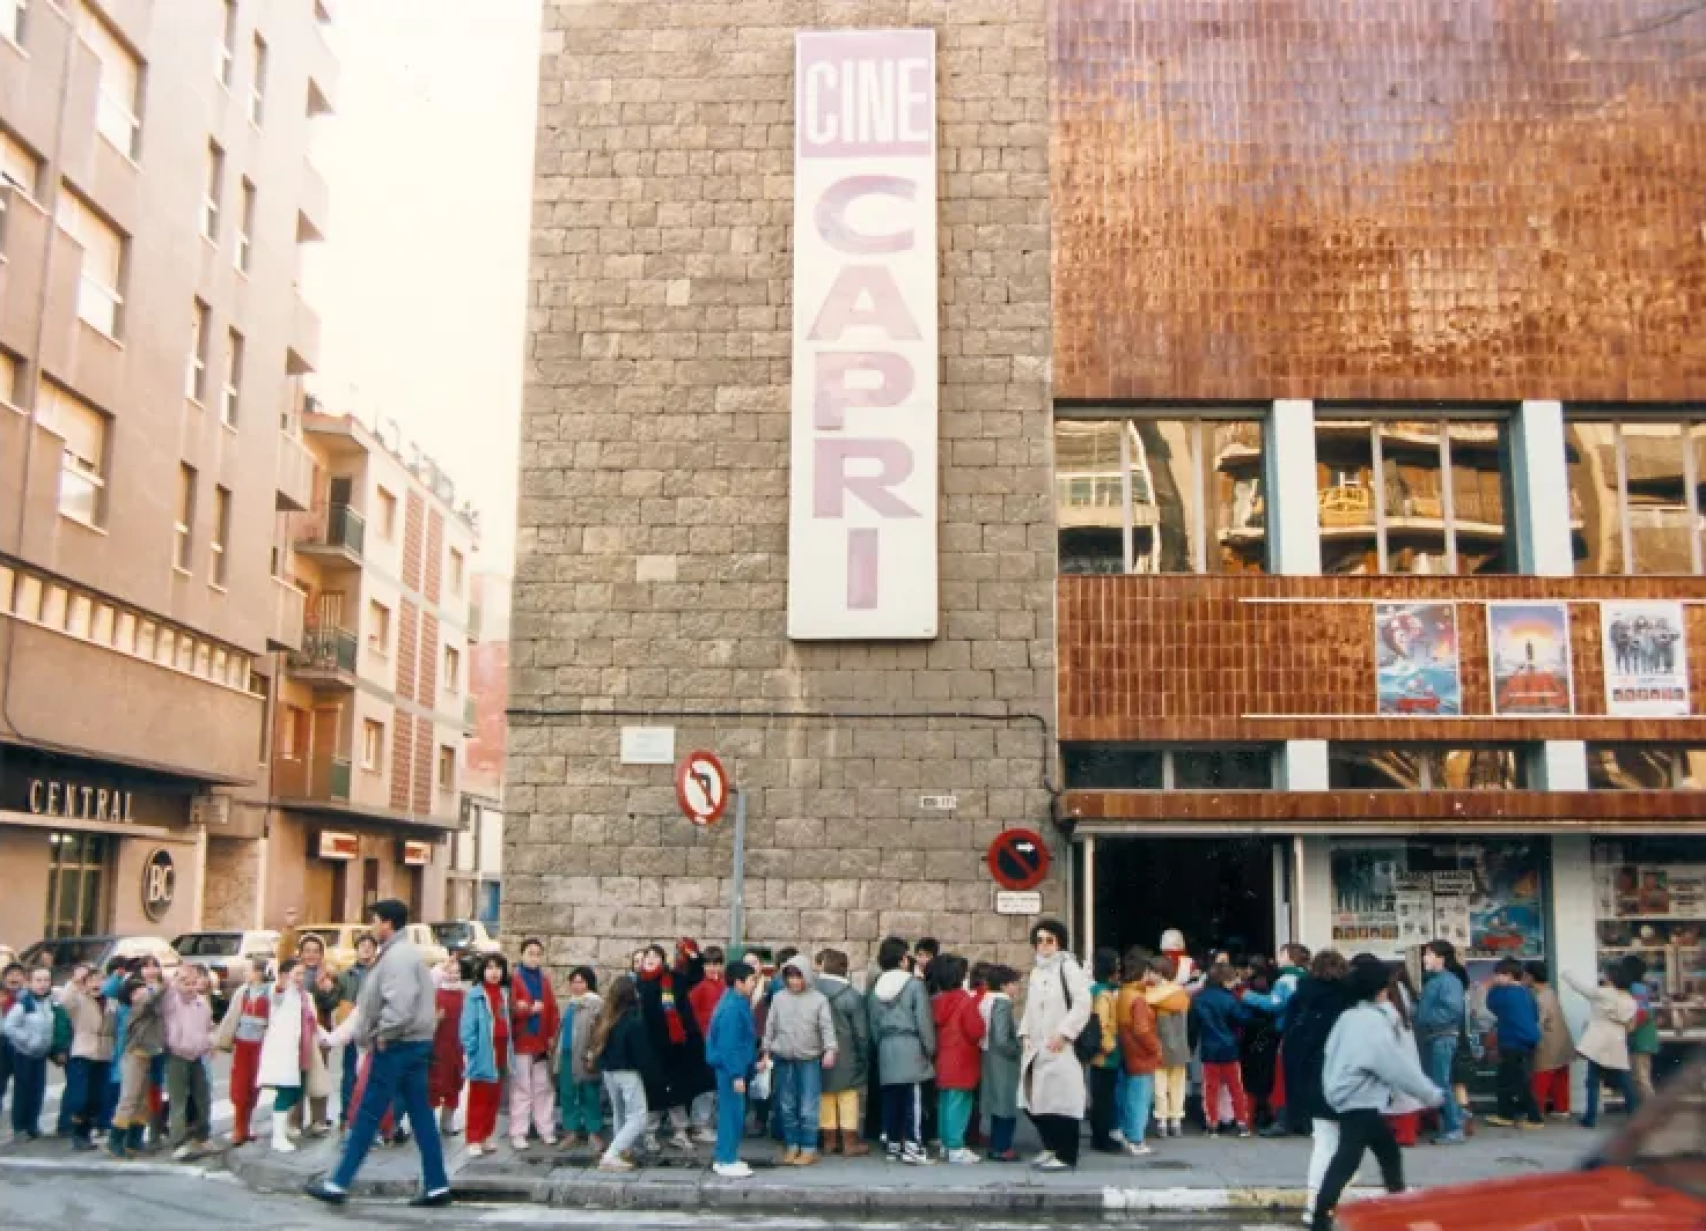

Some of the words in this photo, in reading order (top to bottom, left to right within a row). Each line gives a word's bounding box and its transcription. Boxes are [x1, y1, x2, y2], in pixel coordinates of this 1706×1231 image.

[806, 57, 928, 144] CINE
[805, 174, 924, 609] CAPRI
[29, 779, 133, 823] CENTRAL
[148, 864, 174, 902] BC
